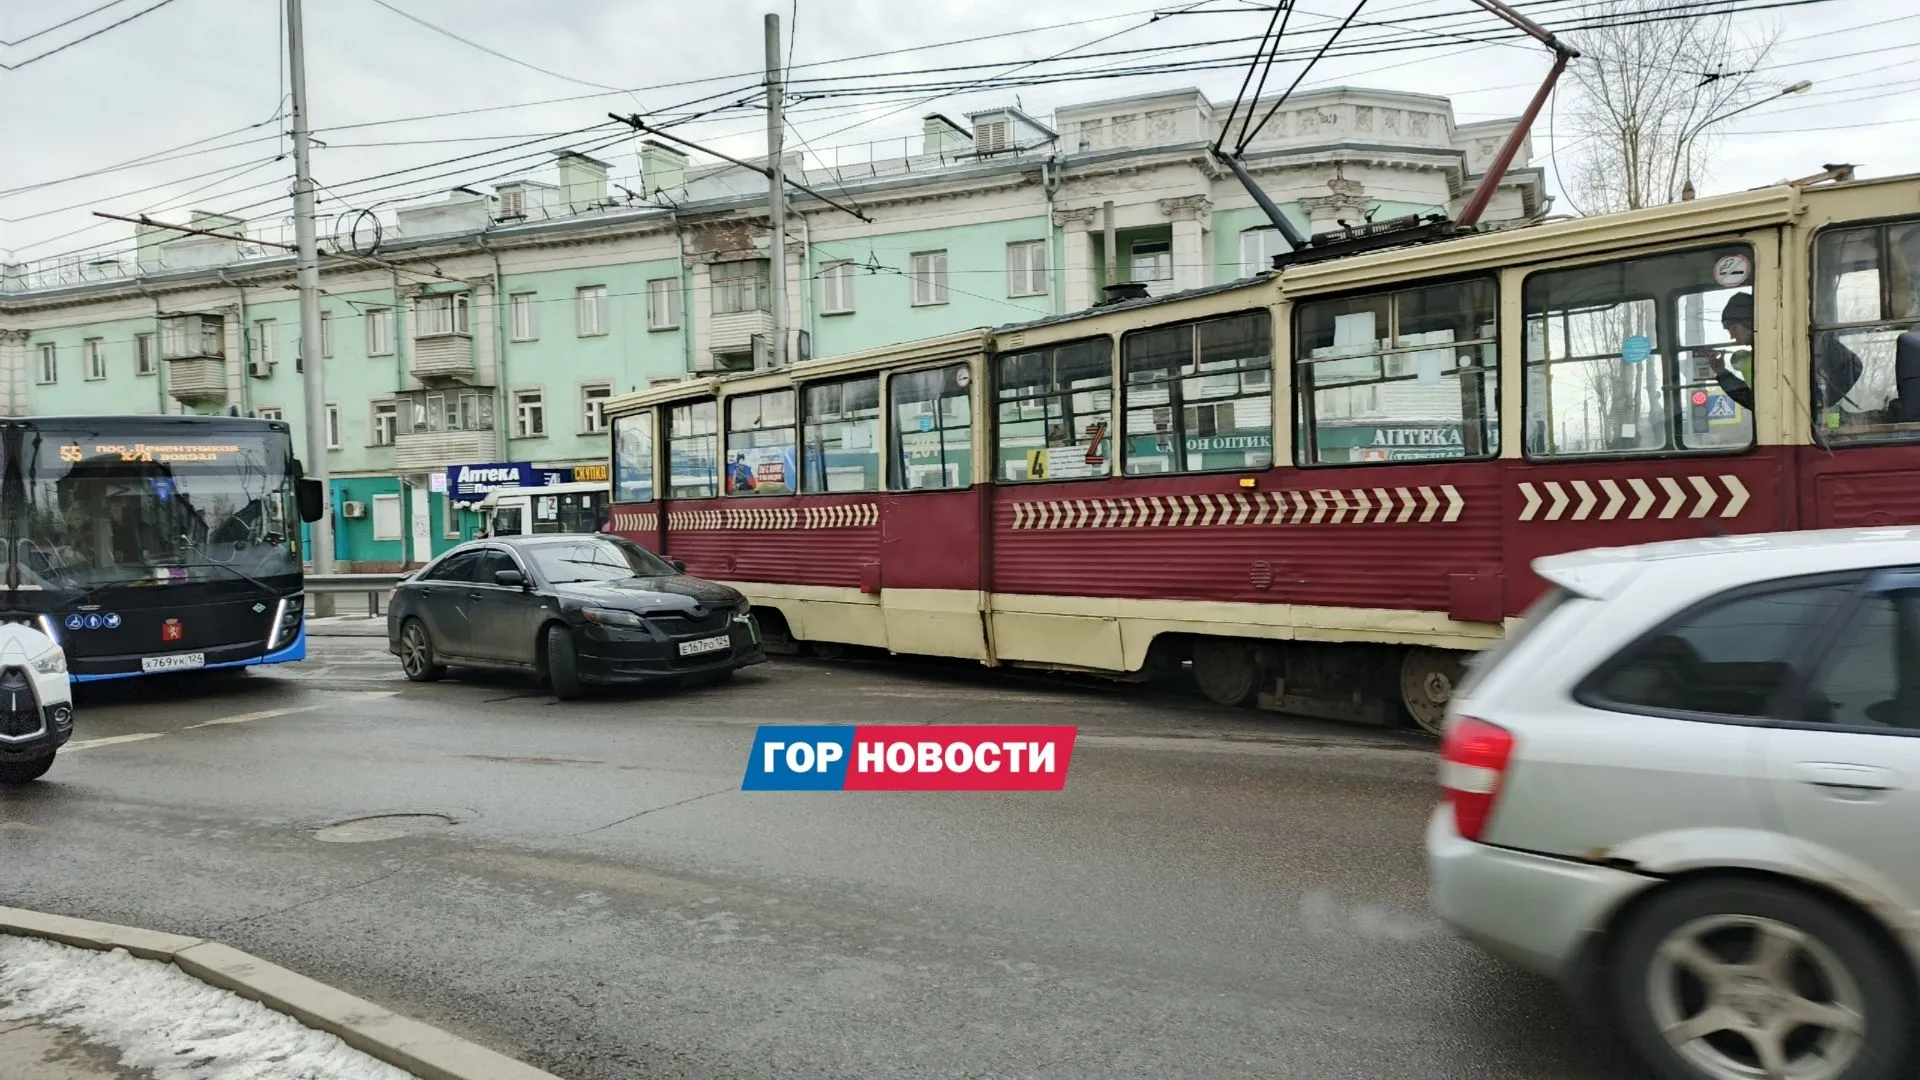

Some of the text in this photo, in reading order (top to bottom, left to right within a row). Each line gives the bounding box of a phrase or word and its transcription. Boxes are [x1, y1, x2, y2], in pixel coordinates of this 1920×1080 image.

[1372, 428, 1463, 446] АПТЕКА
[59, 445, 82, 462] 55
[575, 465, 607, 480] СКУПКА
[1031, 450, 1044, 479] 4
